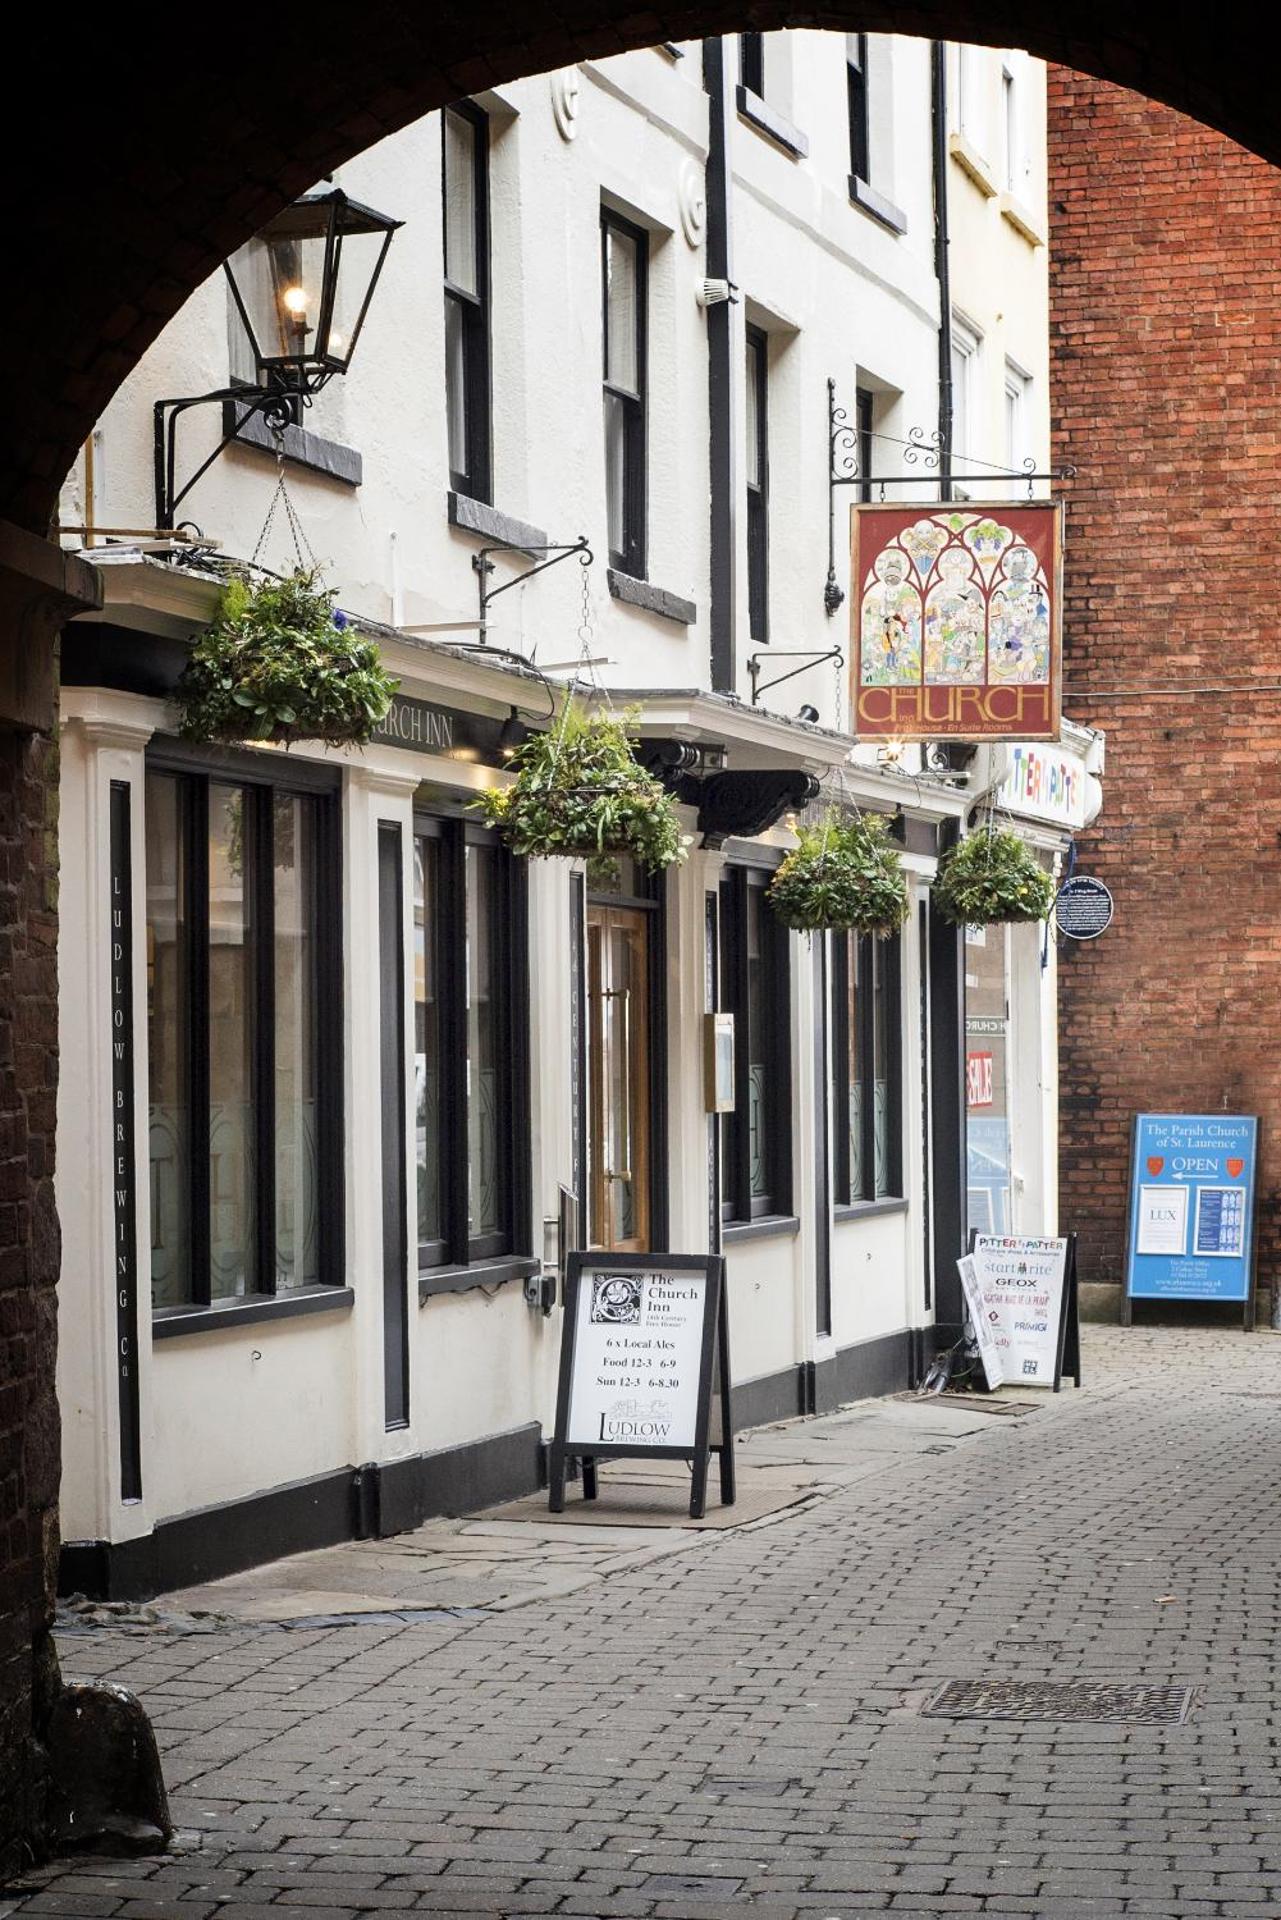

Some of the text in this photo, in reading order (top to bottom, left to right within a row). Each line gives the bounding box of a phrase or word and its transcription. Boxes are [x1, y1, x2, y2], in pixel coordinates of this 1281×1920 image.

[858, 687, 1049, 723] CHURCH
[426, 711, 454, 749] INN
[113, 876, 125, 1060] LUDLOW
[1146, 1124, 1249, 1138] The Parish Church
[1156, 1136, 1169, 1148] of
[1187, 1137, 1237, 1149] Laurence
[1172, 1157, 1219, 1171] OPEN
[116, 1089, 128, 1308] BREWING
[1150, 1209, 1176, 1221] LUX
[979, 1237, 1017, 1249] PITTER
[1026, 1240, 1063, 1250] PATTER
[1029, 1264, 1052, 1276] rite
[650, 1273, 675, 1286] The
[995, 1278, 1037, 1288] GEOX
[649, 1287, 698, 1300] Church
[648, 1301, 671, 1312] Inn
[606, 1338, 676, 1349] 6 x Local Ales
[602, 1357, 677, 1369] Food 12-3 6-9
[596, 1375, 617, 1386] Sun
[619, 1377, 641, 1387] 12-3
[598, 1412, 671, 1441] LUDLOW
